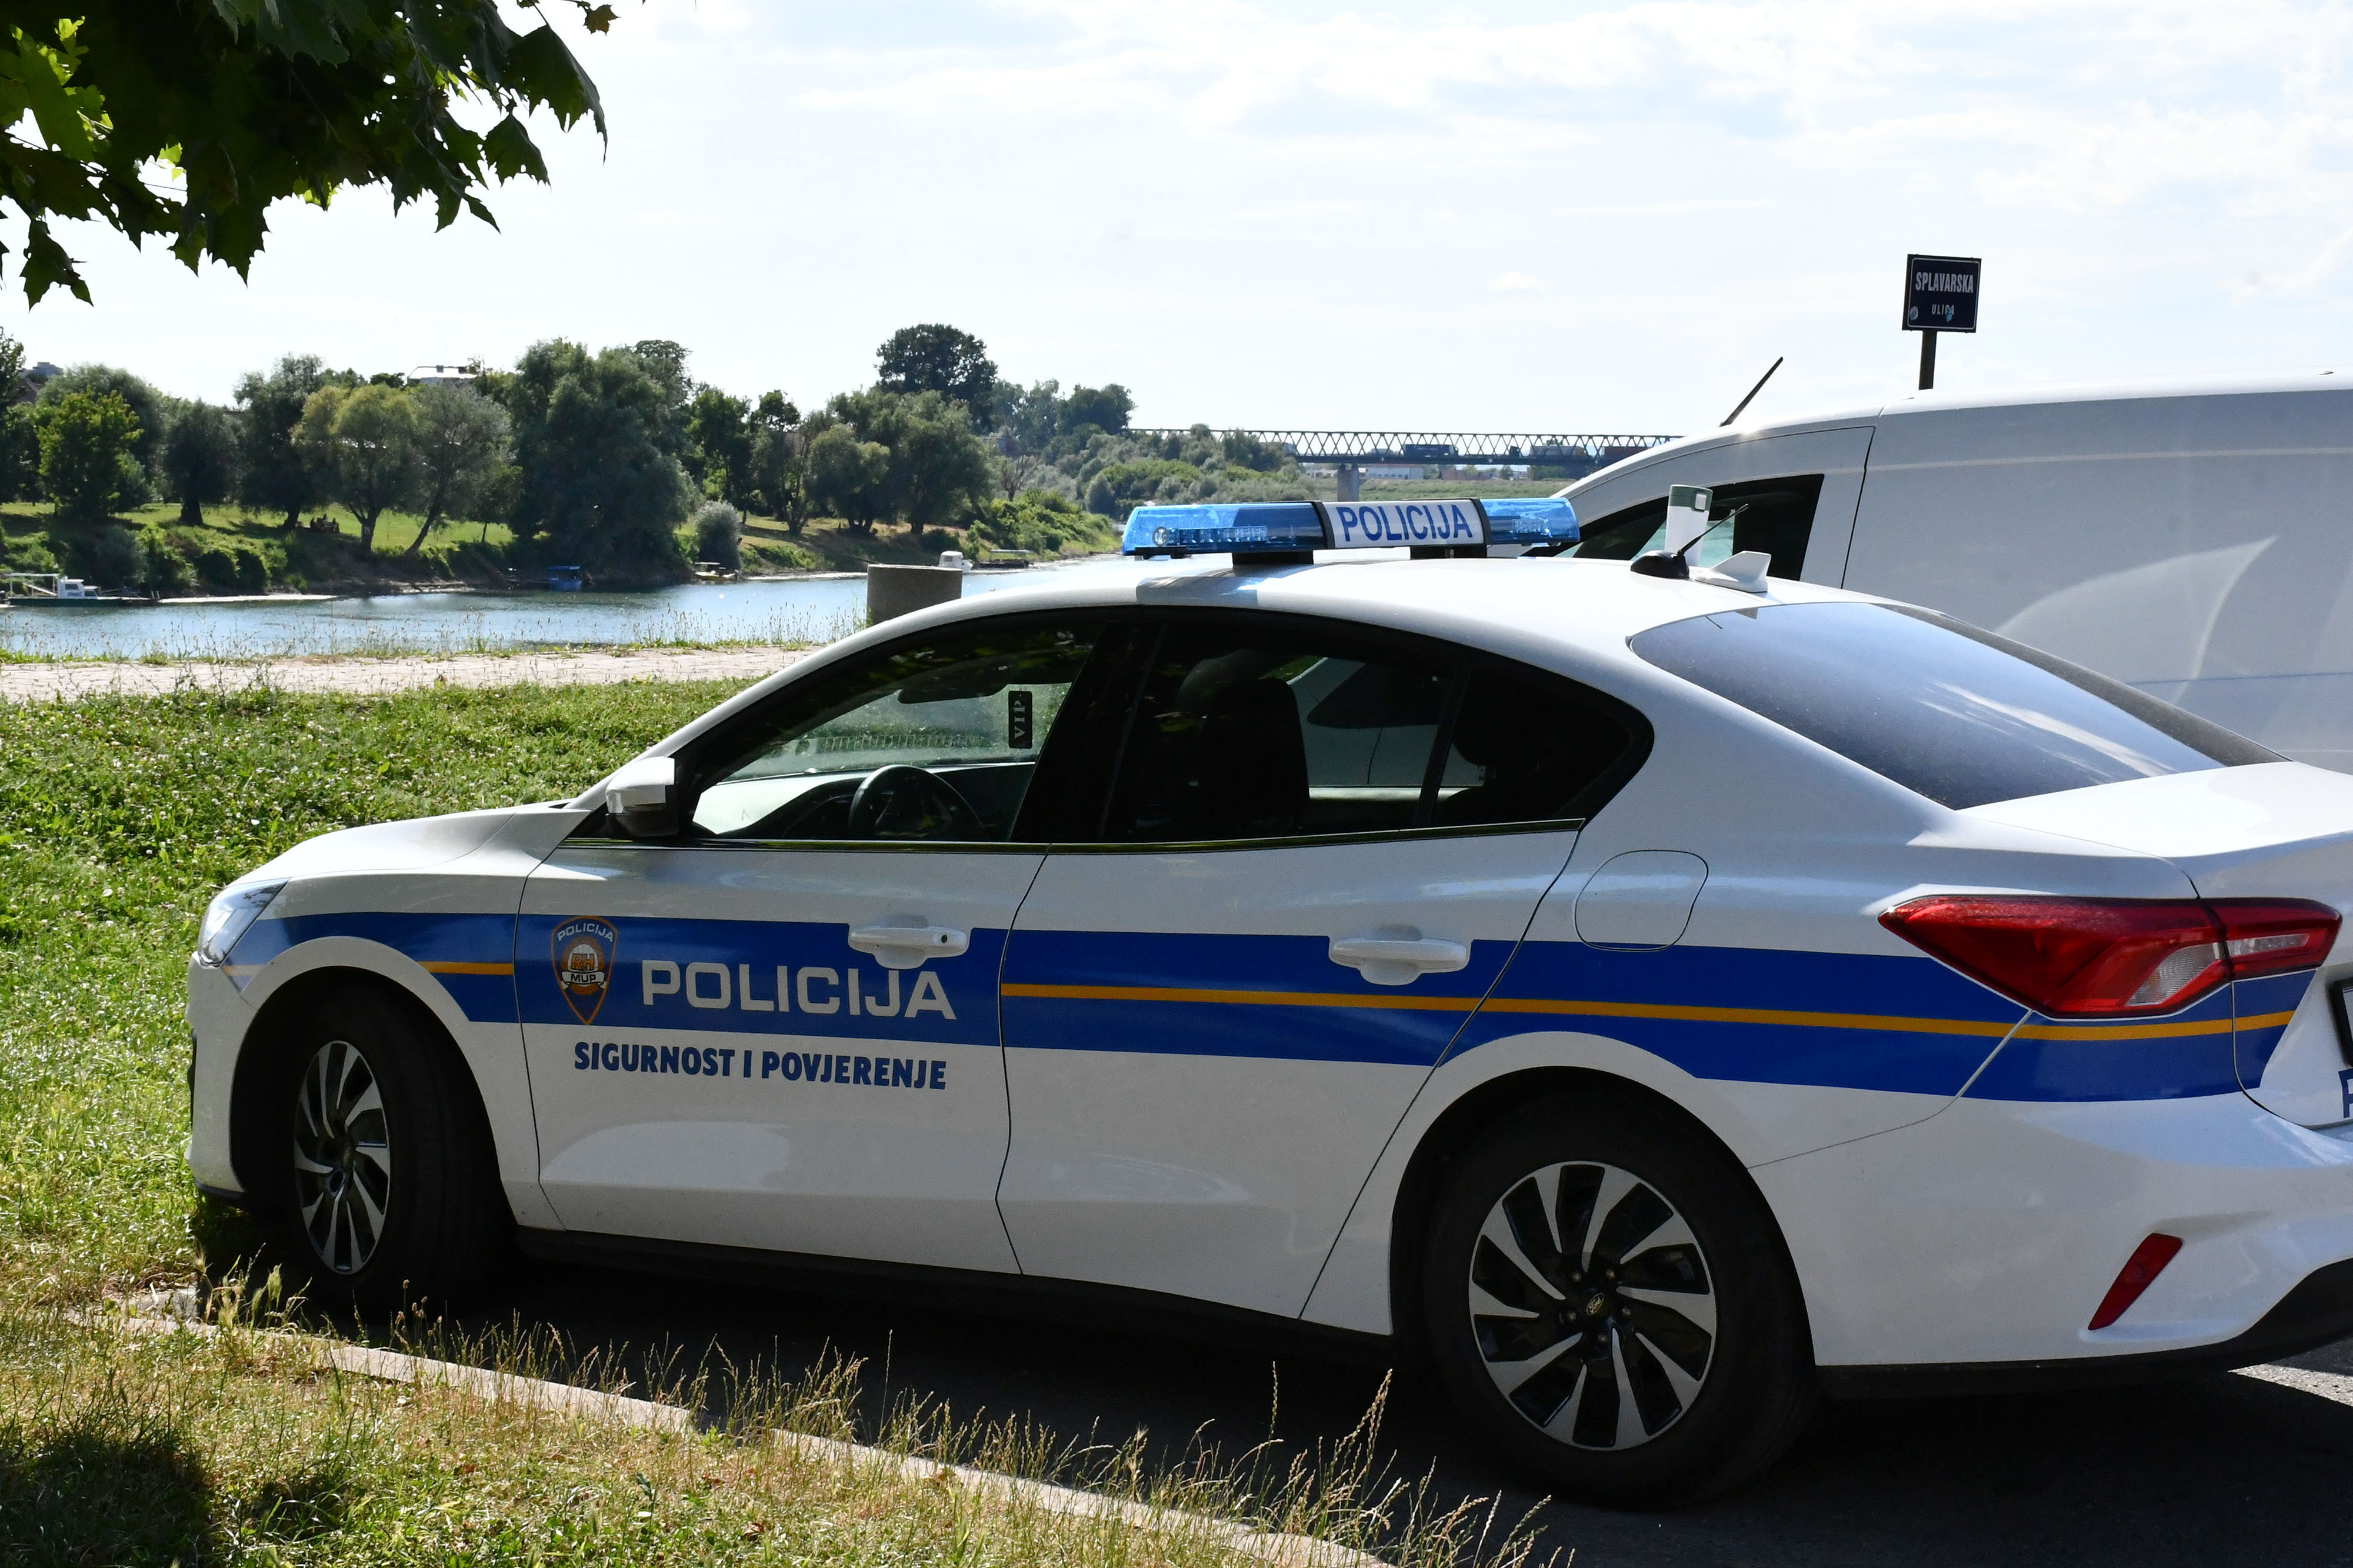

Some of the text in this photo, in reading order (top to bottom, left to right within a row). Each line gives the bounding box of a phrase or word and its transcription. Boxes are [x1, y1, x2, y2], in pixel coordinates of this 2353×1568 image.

[1915, 272, 1974, 293] SPLAVARSKA
[1336, 504, 1473, 542] POLICIJA
[1013, 700, 1025, 739] VIP
[557, 923, 613, 942] POLICIJA
[571, 953, 595, 971] RH
[571, 973, 596, 982] MUP
[642, 960, 956, 1020] POLICIJA
[574, 1042, 947, 1089] SIGURNOST I POVJERENJE
